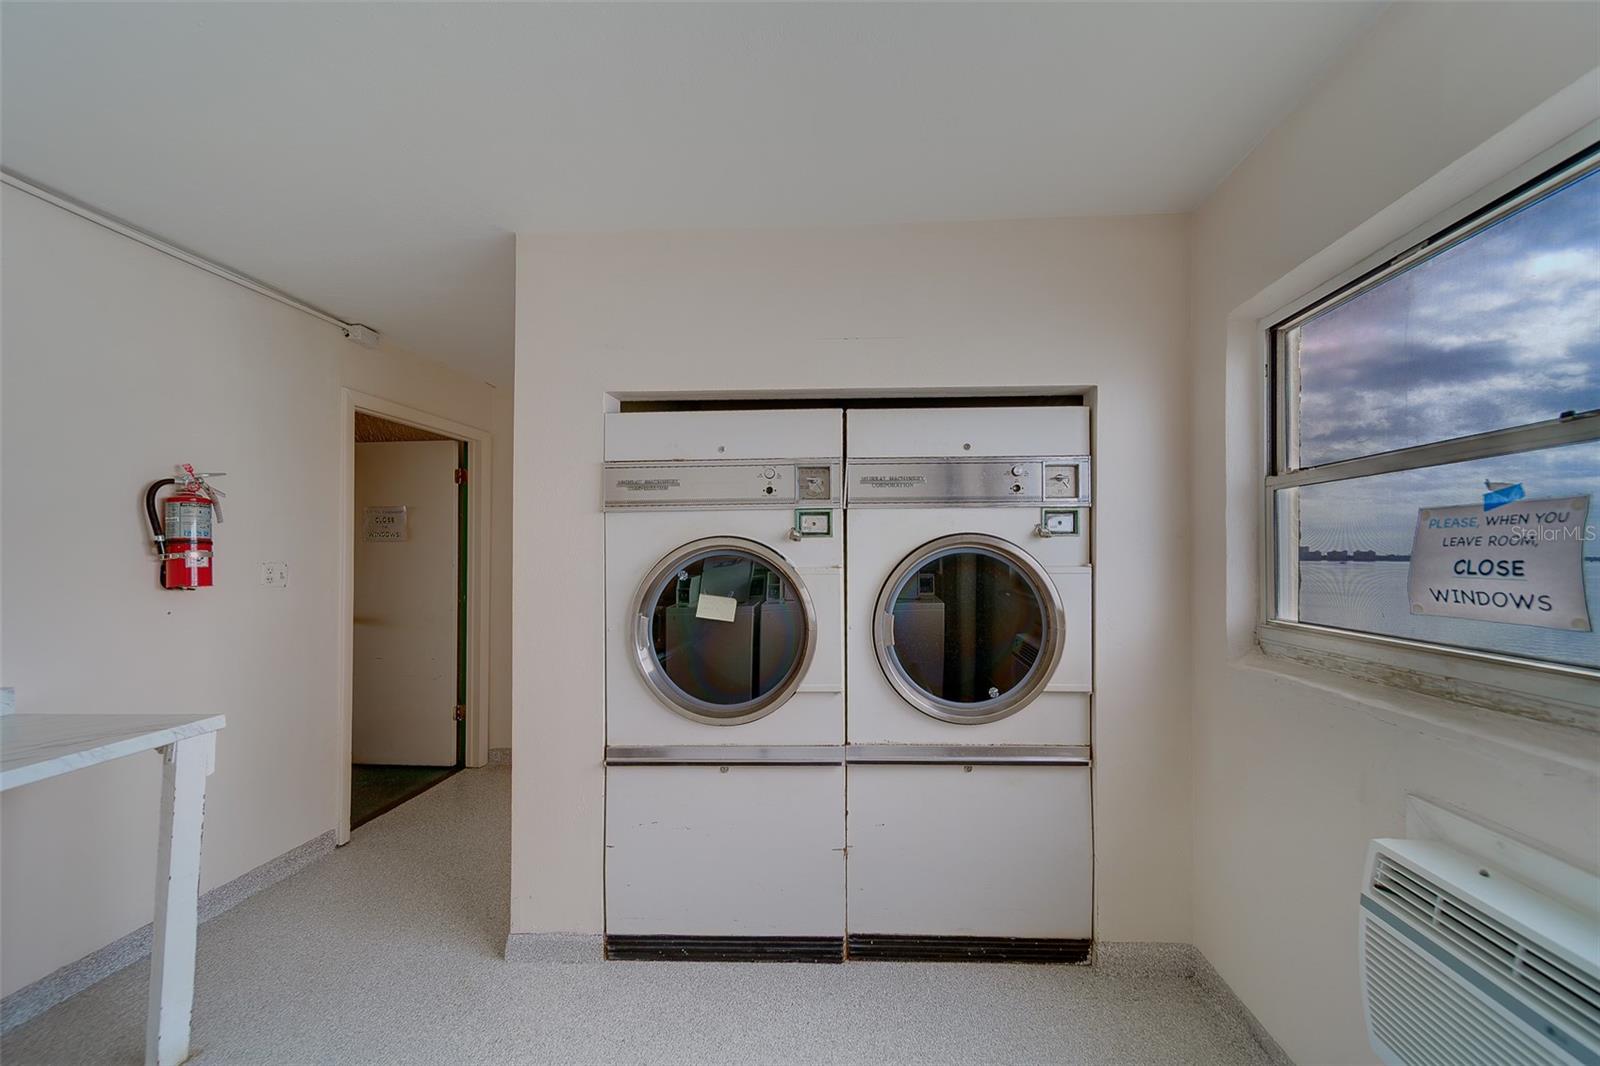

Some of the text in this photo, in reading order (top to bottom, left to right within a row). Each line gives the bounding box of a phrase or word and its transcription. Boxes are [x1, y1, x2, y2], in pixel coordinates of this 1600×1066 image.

[1428, 511, 1570, 529] PLEASE, WHEN YOU
[1442, 536, 1483, 548] LEAVE
[1453, 558, 1525, 577] CLOSE
[1429, 587, 1553, 612] WINDOWS
